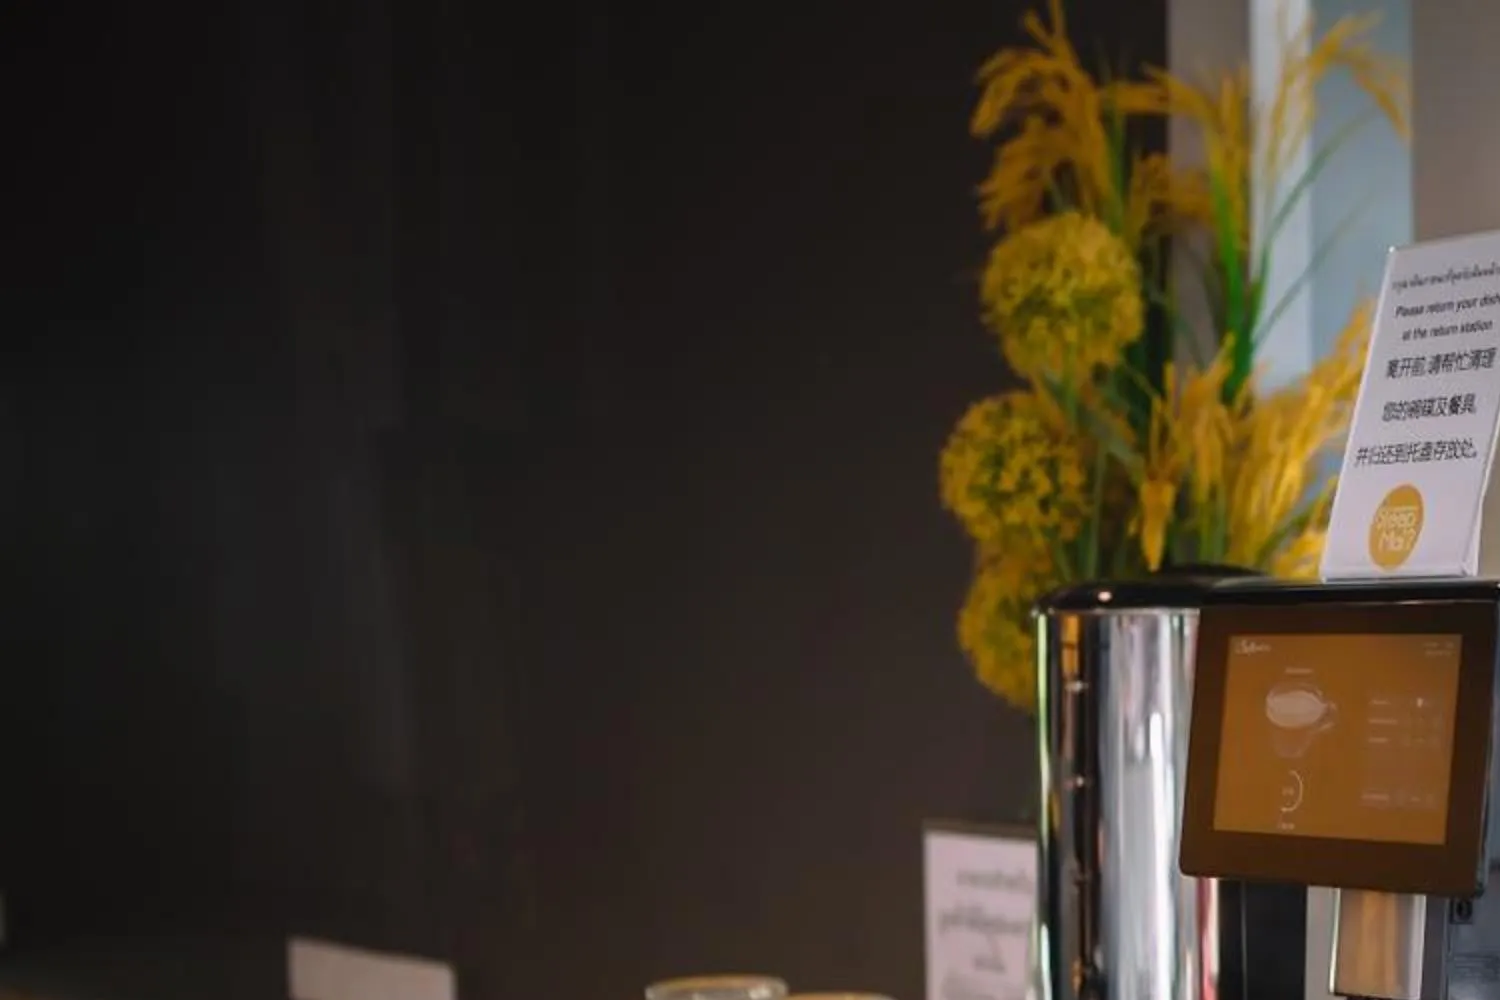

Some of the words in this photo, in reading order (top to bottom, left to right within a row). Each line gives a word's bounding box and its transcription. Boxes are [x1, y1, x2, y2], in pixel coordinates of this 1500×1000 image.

[1395, 305, 1424, 317] Please
[1426, 301, 1455, 314] return
[1456, 298, 1478, 312] your
[1402, 330, 1411, 341] at
[1413, 328, 1427, 339] the
[1430, 325, 1458, 337] return
[1461, 319, 1493, 334] station
